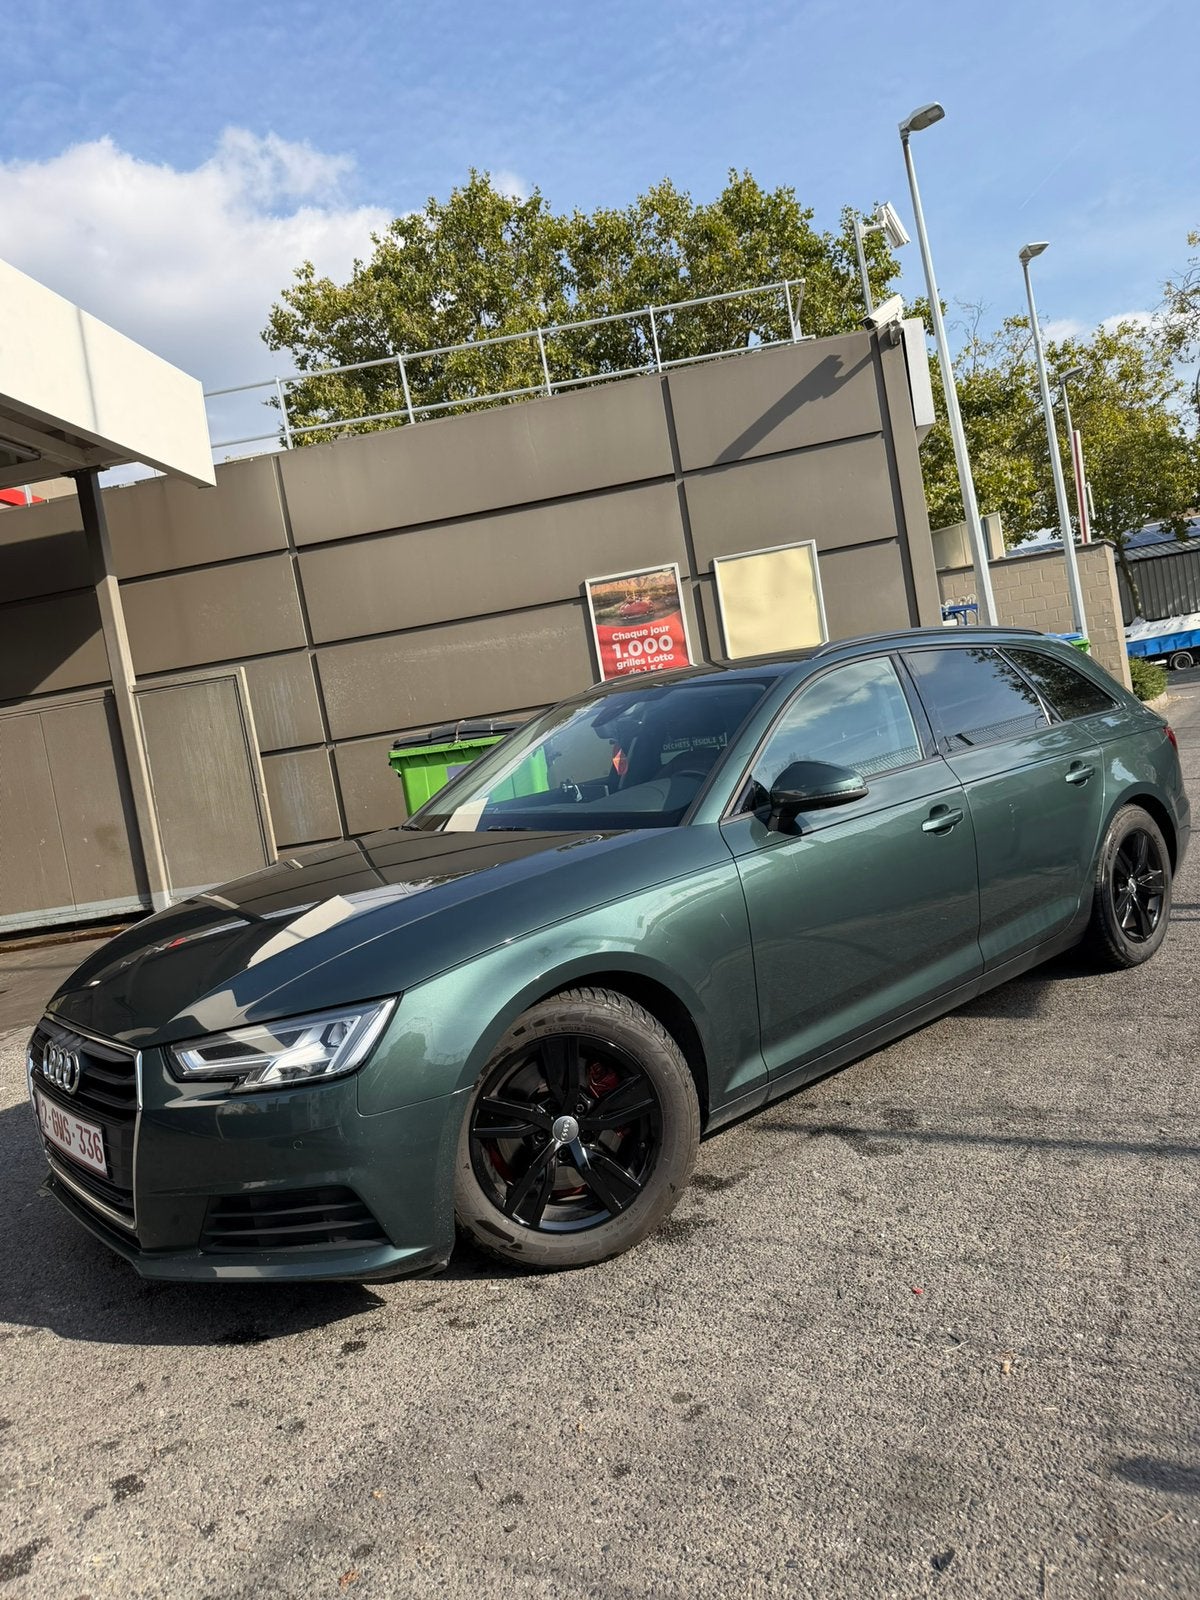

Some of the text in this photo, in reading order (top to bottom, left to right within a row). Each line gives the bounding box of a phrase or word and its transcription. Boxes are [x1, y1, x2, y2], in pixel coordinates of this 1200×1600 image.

[612, 625, 670, 641] Chaque jour
[611, 635, 673, 659] 1.000
[616, 653, 674, 670] grilles Lotto
